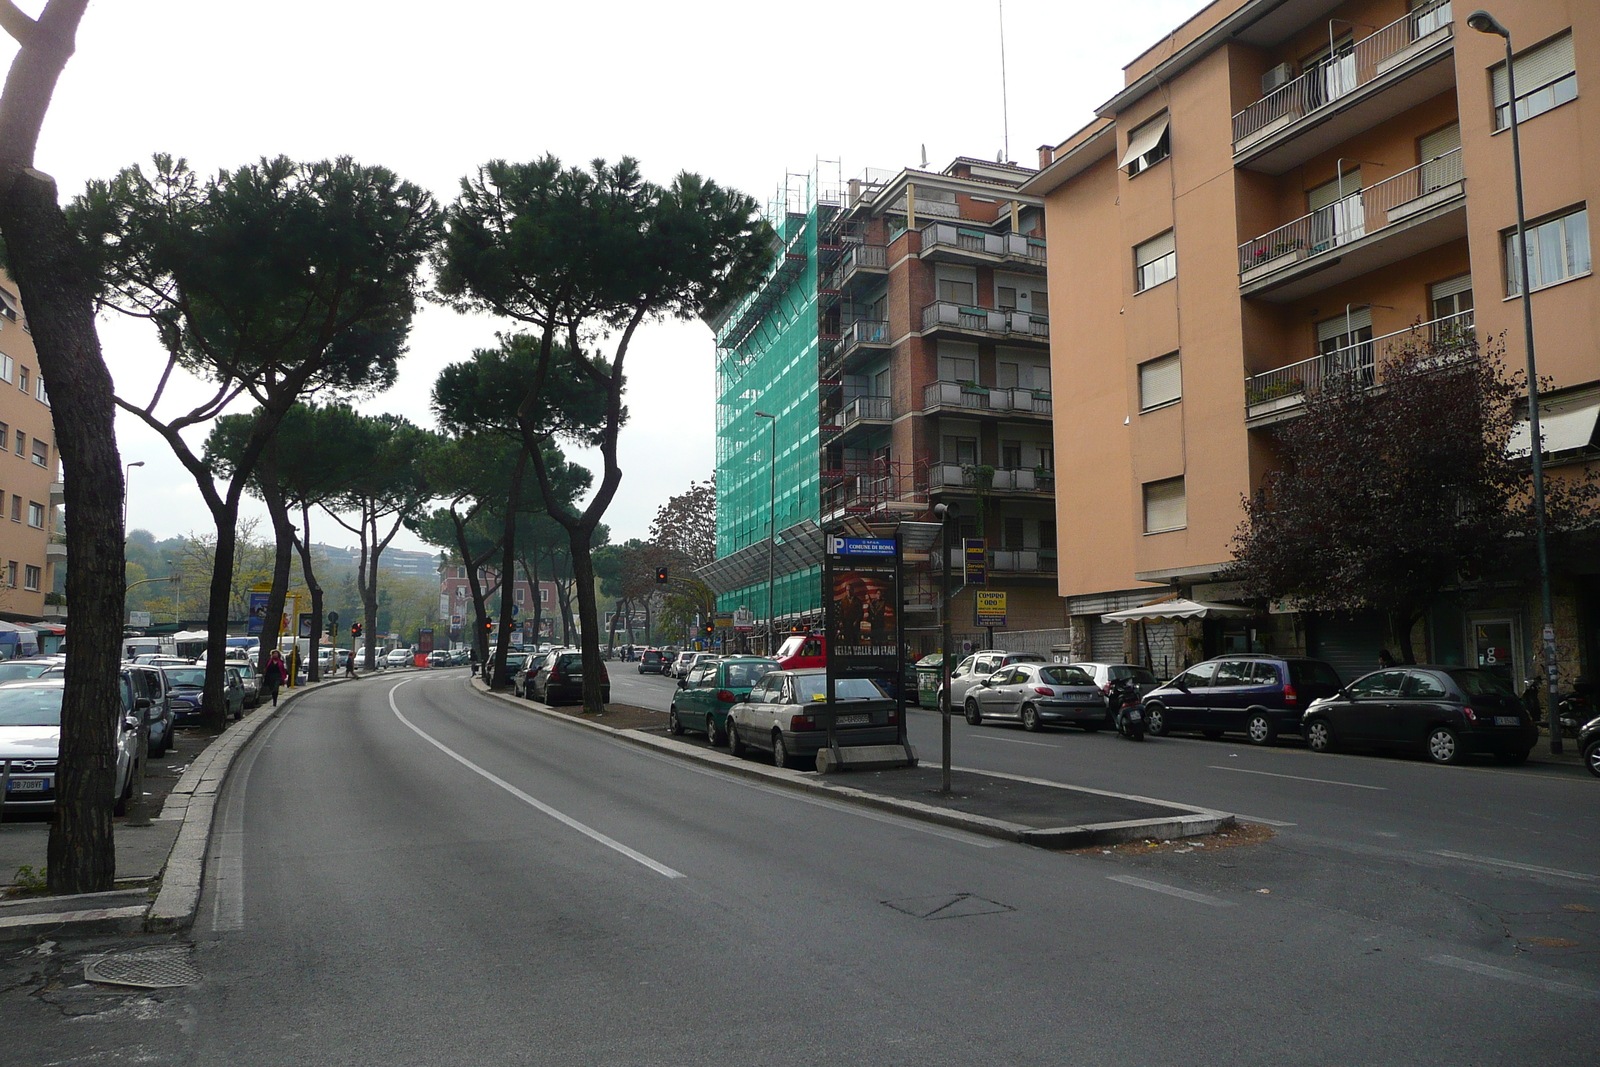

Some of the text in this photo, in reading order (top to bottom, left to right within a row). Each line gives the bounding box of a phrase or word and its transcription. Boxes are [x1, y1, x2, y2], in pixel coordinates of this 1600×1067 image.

[852, 645, 872, 656] VALLE
[872, 645, 880, 656] DI
[881, 645, 896, 656] ELAH
